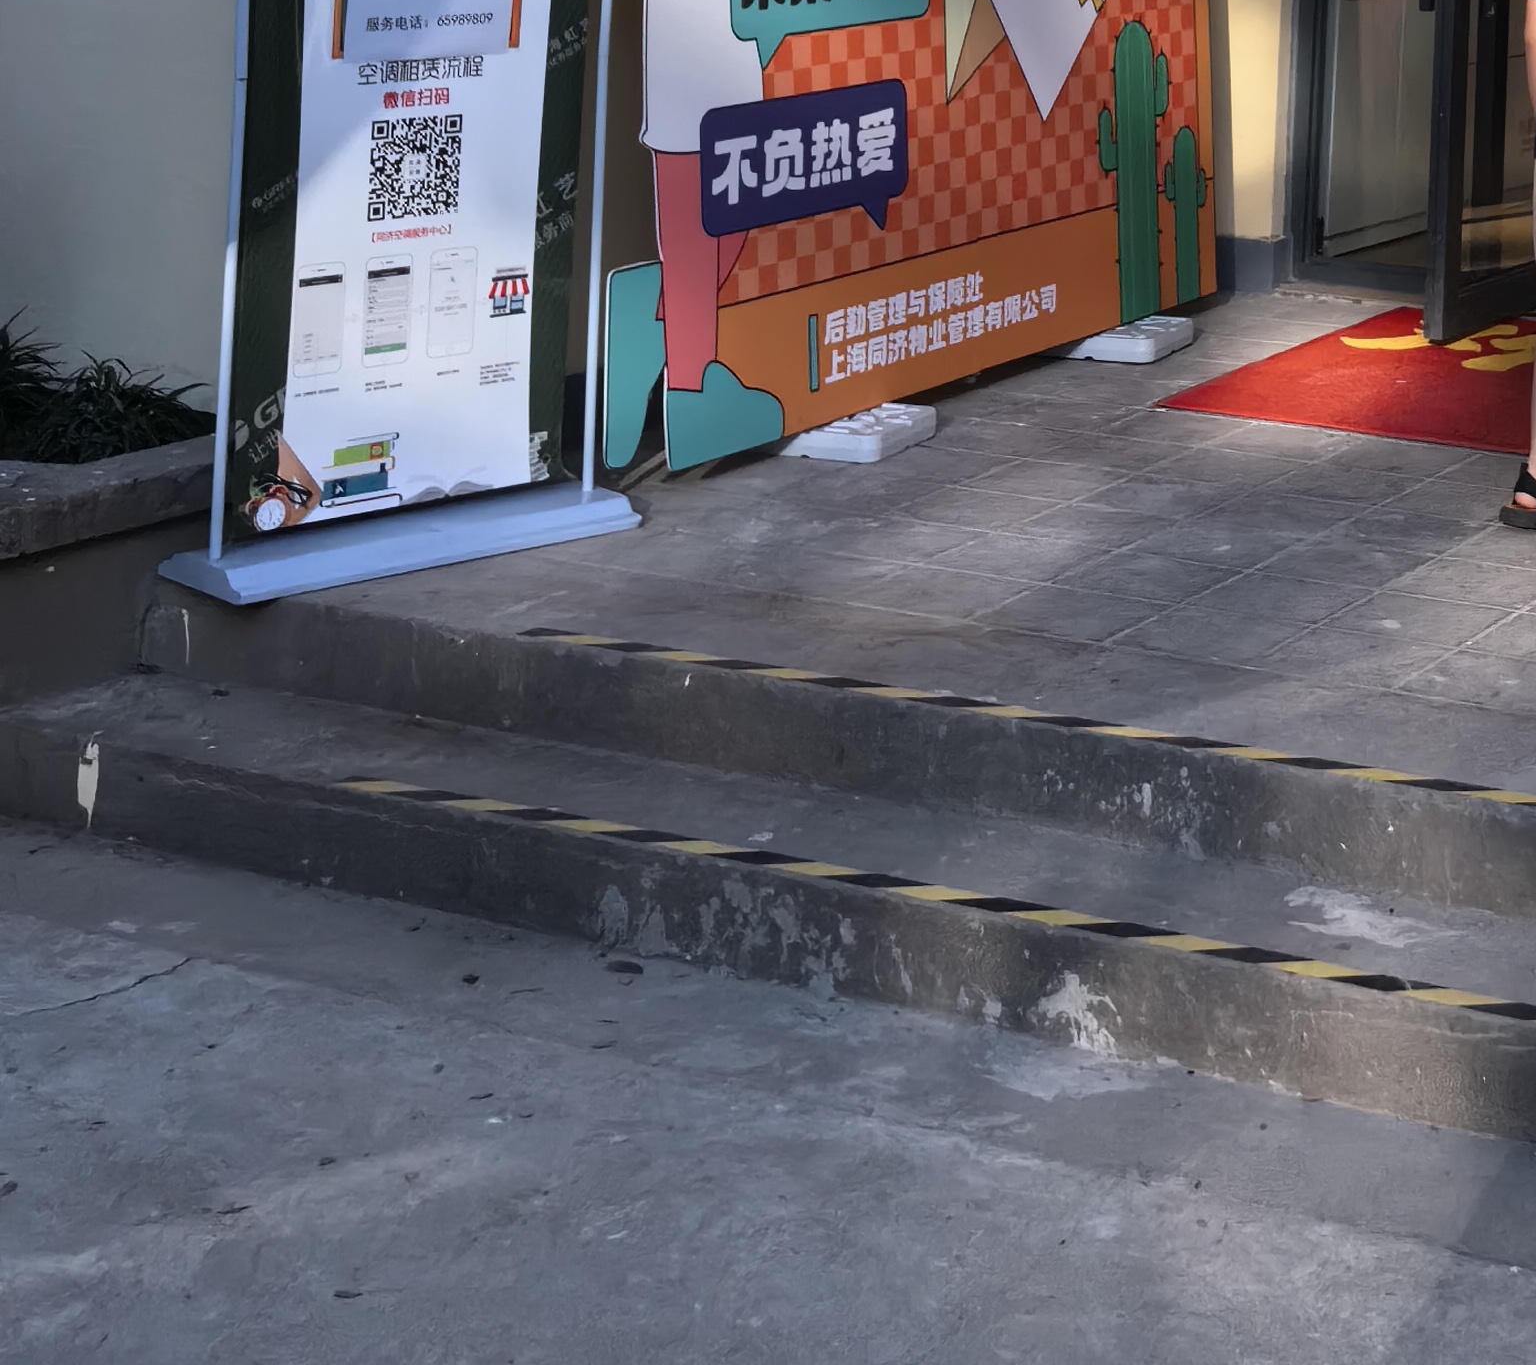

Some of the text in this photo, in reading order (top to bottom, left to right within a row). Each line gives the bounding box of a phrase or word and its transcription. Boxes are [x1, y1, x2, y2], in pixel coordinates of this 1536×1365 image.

[358, 55, 484, 85] 空调租赁流程
[383, 87, 450, 109] 微信扫码
[712, 107, 896, 205] 不负热爱
[824, 271, 984, 345] 后勤管理与保障处
[824, 283, 1057, 384] 上海同济物业管理有限公司
